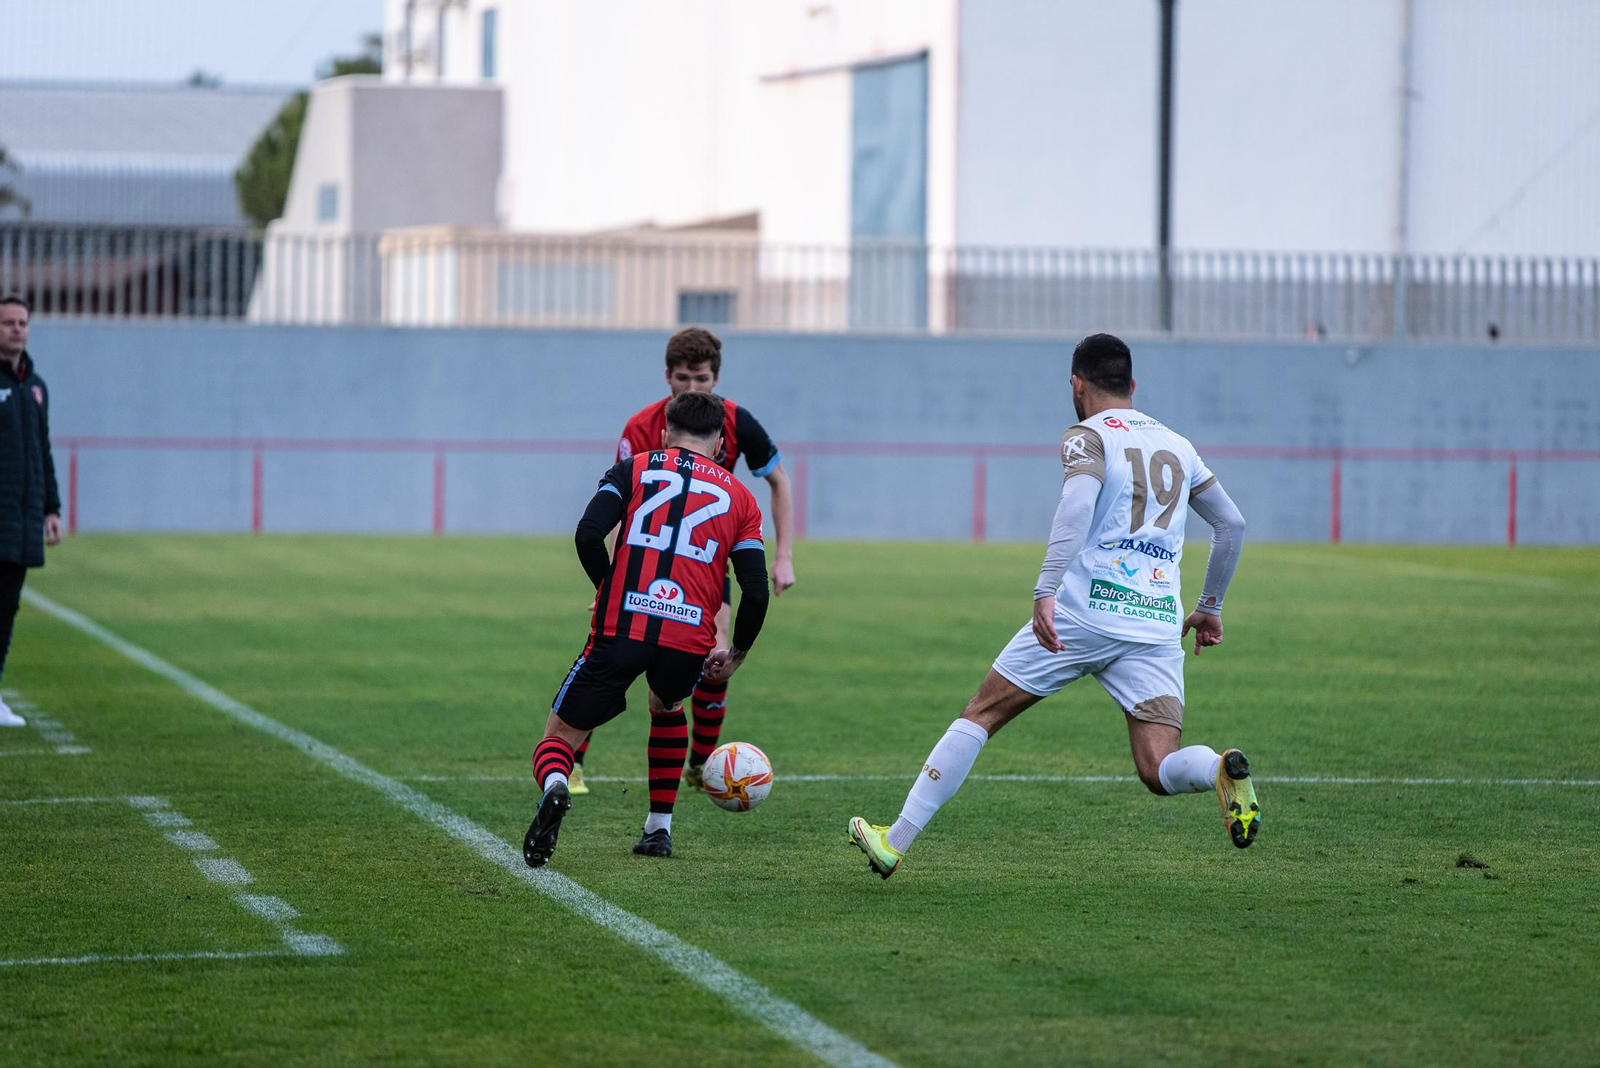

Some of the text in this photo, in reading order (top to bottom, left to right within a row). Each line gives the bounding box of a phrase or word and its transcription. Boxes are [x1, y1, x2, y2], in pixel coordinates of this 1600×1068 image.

[650, 453, 732, 487] AD CARTAYA
[1123, 448, 1185, 534] 19
[626, 469, 732, 565] 22
[628, 594, 698, 618] toscamare
[1088, 601, 1177, 625] R.C.M. GASÓLEOS
[1091, 584, 1176, 612] Petro Markt
